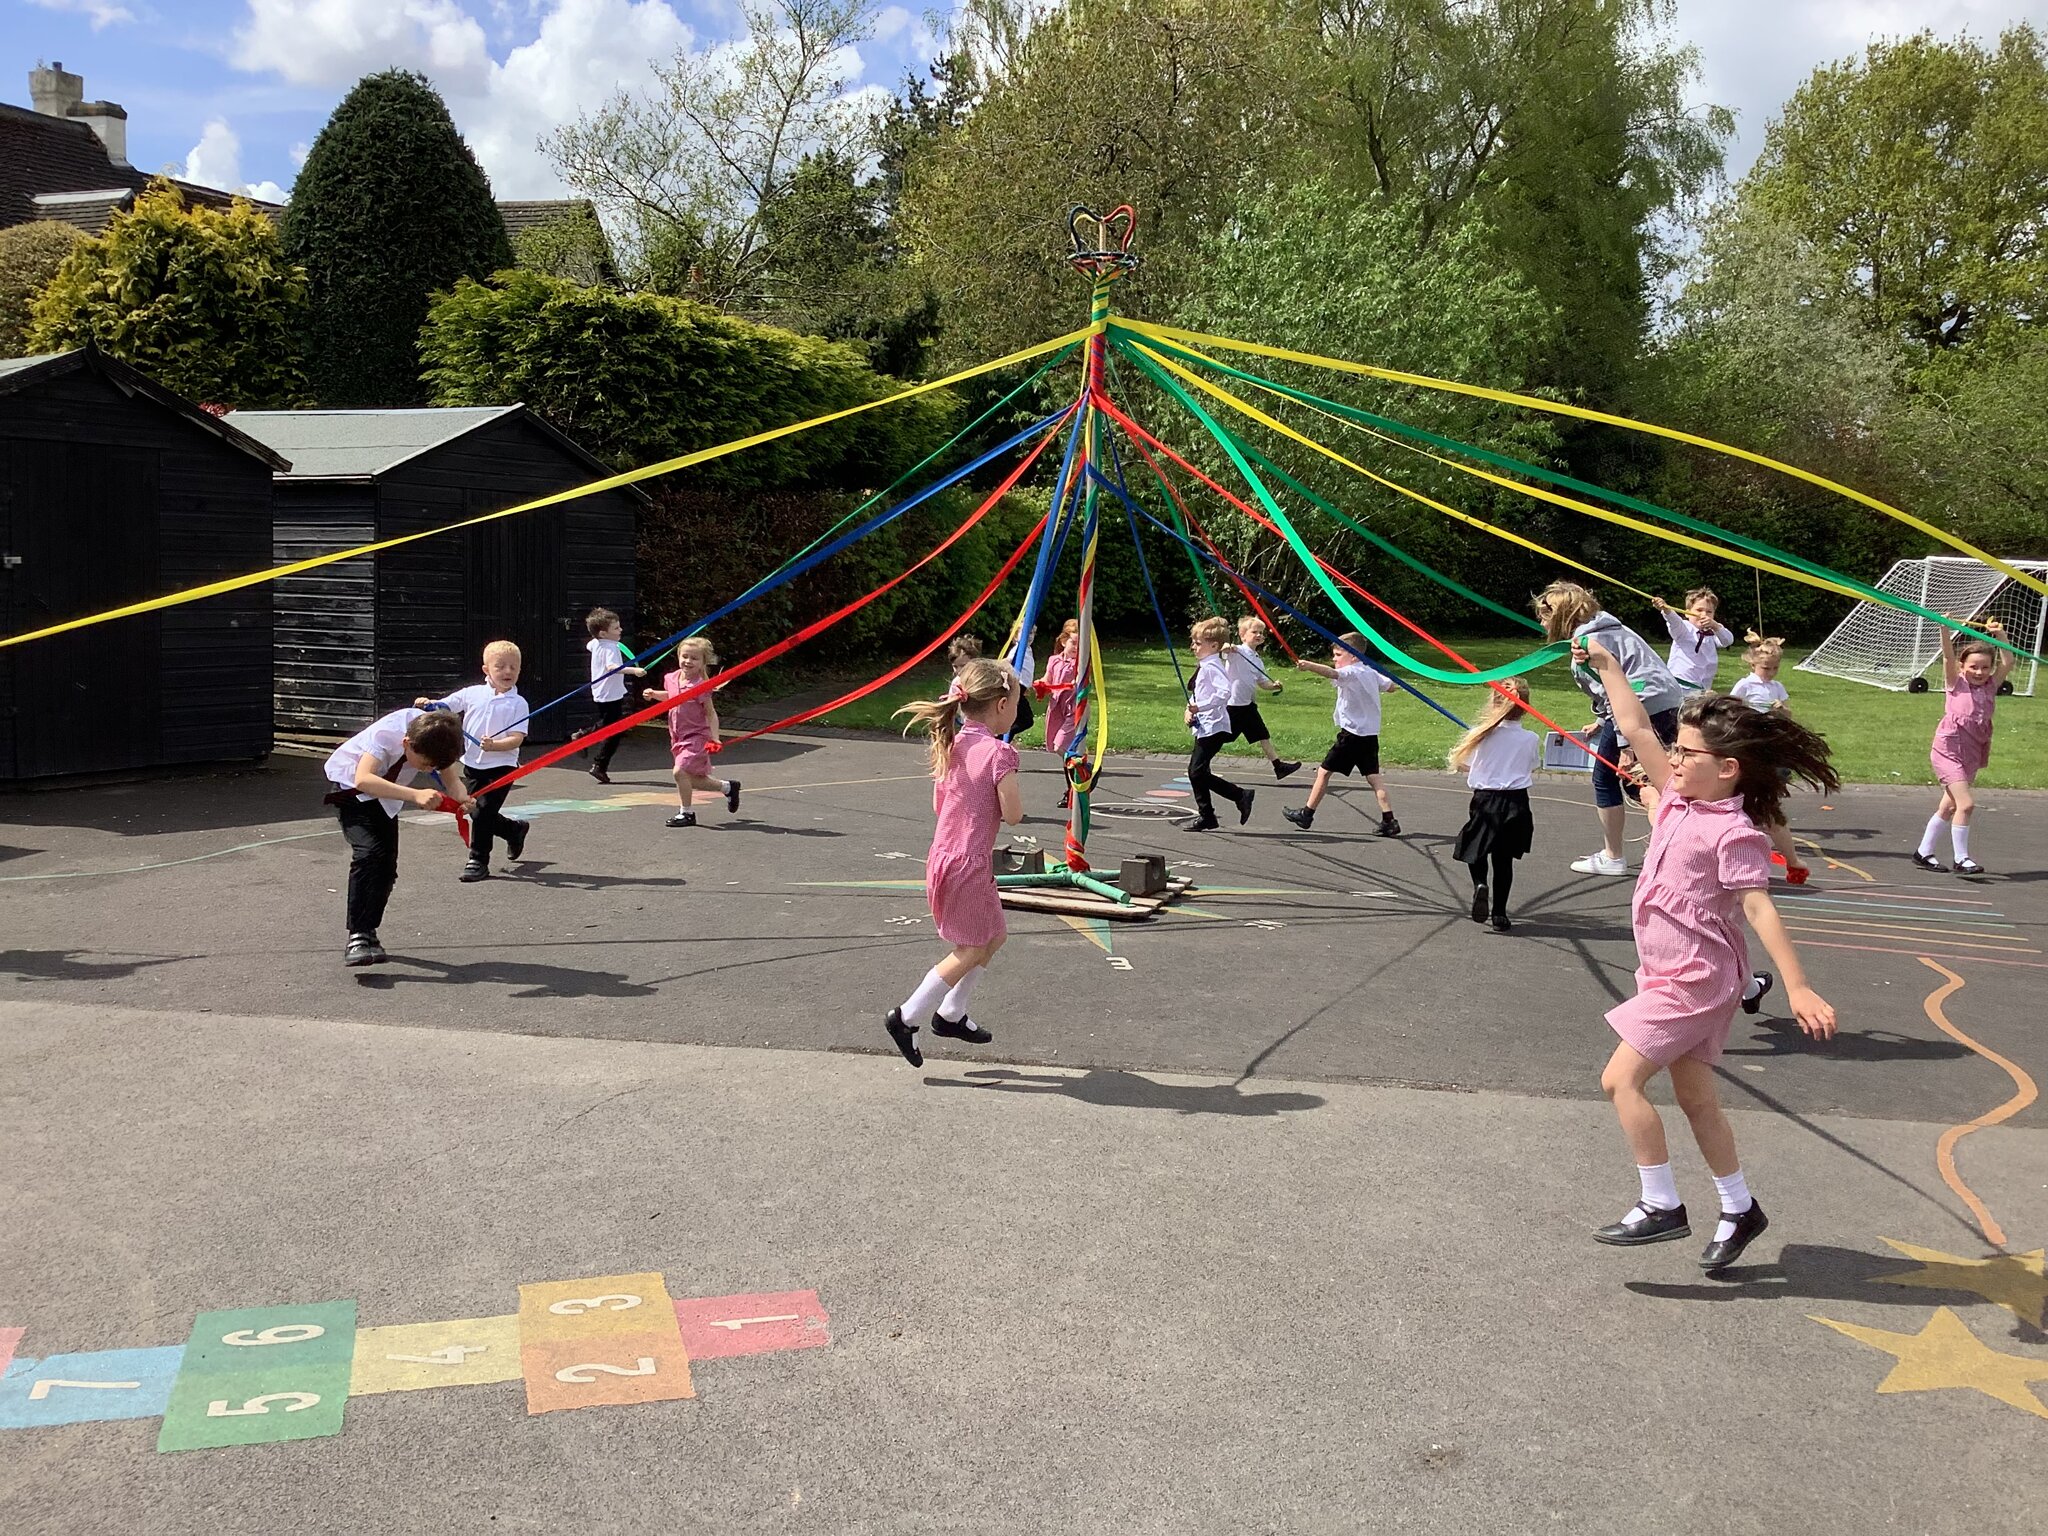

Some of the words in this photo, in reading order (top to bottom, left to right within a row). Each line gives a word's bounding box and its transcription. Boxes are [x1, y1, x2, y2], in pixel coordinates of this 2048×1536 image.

[1105, 956, 1134, 971] E
[549, 1293, 642, 1315] 3
[709, 1314, 799, 1331] 1
[221, 1324, 326, 1347] 6
[386, 1344, 488, 1366] 4
[555, 1357, 657, 1383] 2
[28, 1379, 142, 1400] 7
[206, 1391, 321, 1417] 5
